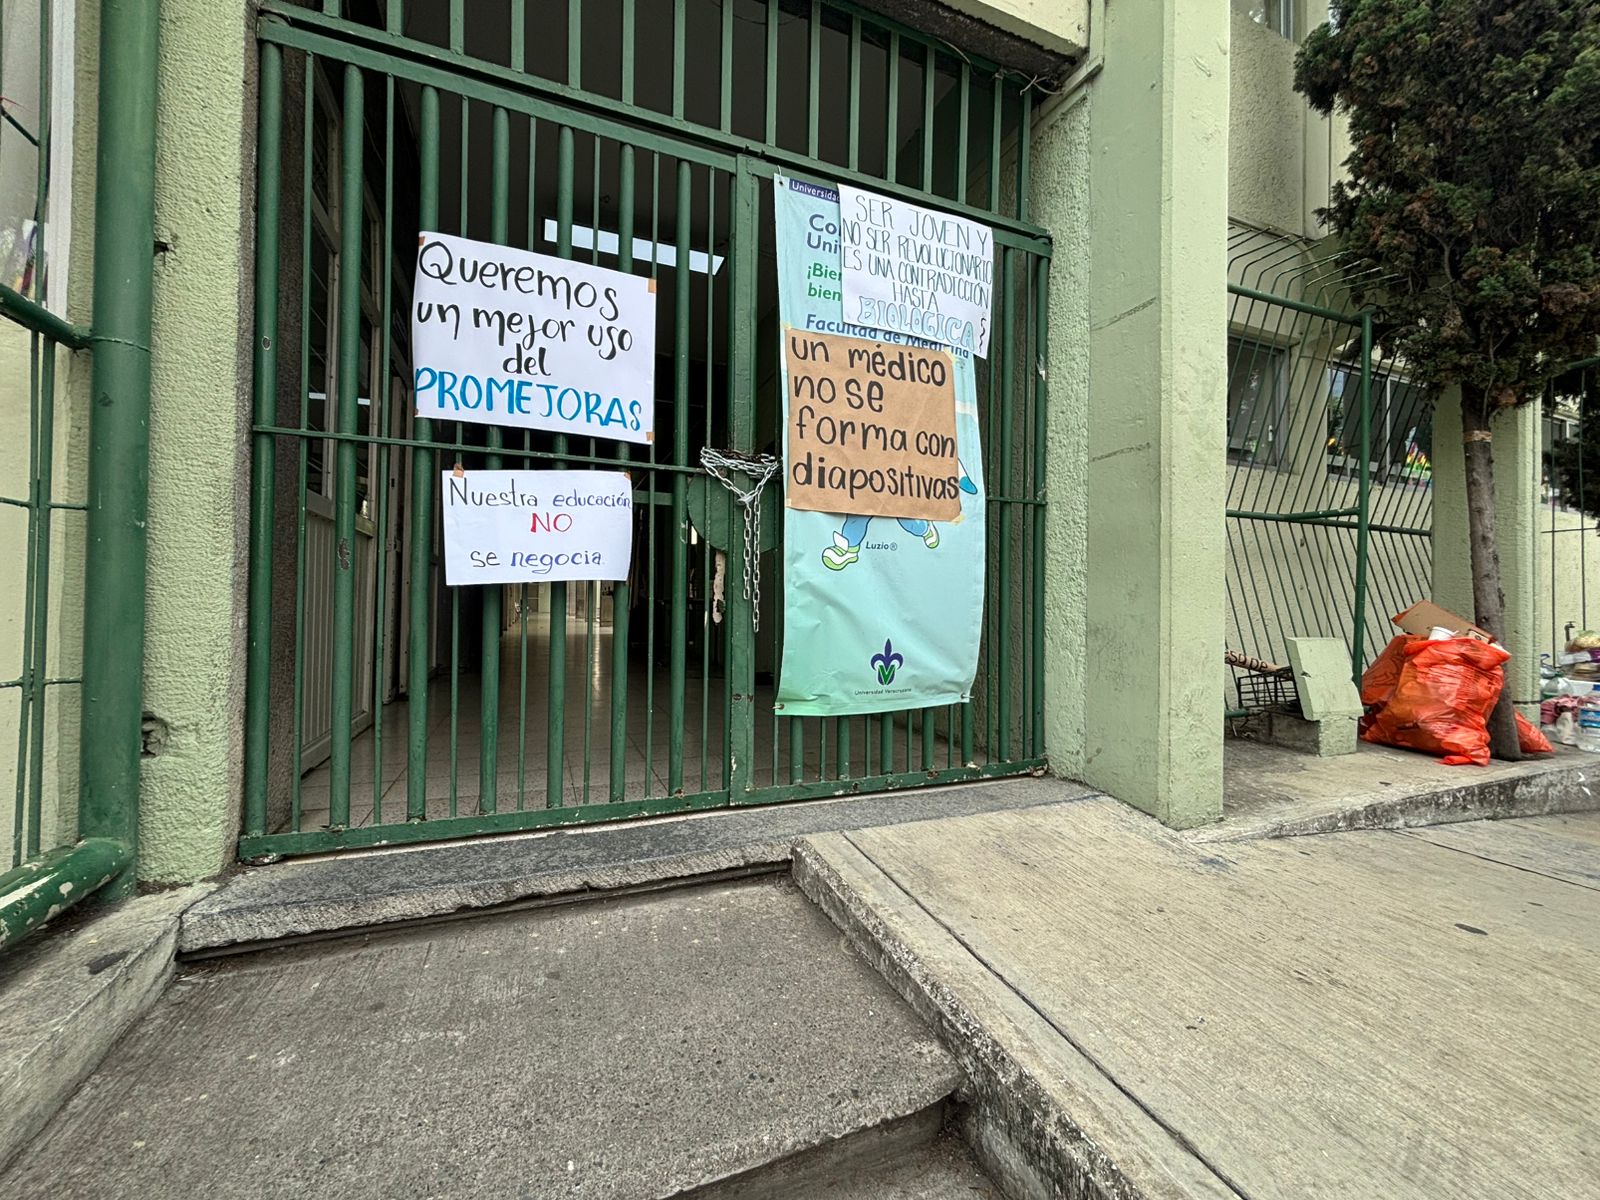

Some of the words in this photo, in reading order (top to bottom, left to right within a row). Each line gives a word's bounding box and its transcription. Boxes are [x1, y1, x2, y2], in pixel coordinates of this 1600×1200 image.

[809, 213, 841, 237] Co
[855, 194, 894, 230] SER
[908, 209, 969, 250] JOVEN
[977, 229, 988, 256] Y
[842, 217, 861, 246] NO
[866, 227, 891, 256] SER
[898, 234, 993, 285] REVOLUCIONARIO
[418, 240, 619, 322] Queremos
[843, 246, 862, 271] ES
[868, 253, 895, 281] UNA
[898, 261, 989, 309] CONTRADICCIÓN
[892, 281, 939, 313] HASTA
[416, 301, 460, 340] un
[472, 307, 576, 350] mejor
[587, 324, 633, 361] uso
[806, 313, 878, 340] Facultad
[883, 330, 901, 344] de
[502, 343, 552, 376] del
[791, 336, 830, 363] un
[848, 343, 946, 387] médico
[415, 366, 642, 432] PROMEJORAS
[793, 375, 836, 404] no
[845, 378, 884, 413] se
[795, 405, 908, 451] forma
[915, 430, 956, 459] con
[449, 477, 538, 507] Nuestra
[552, 488, 631, 510] educación
[792, 451, 960, 500] diapositivas
[530, 511, 573, 533] NO
[470, 550, 501, 568] se
[510, 550, 602, 574] negocia
